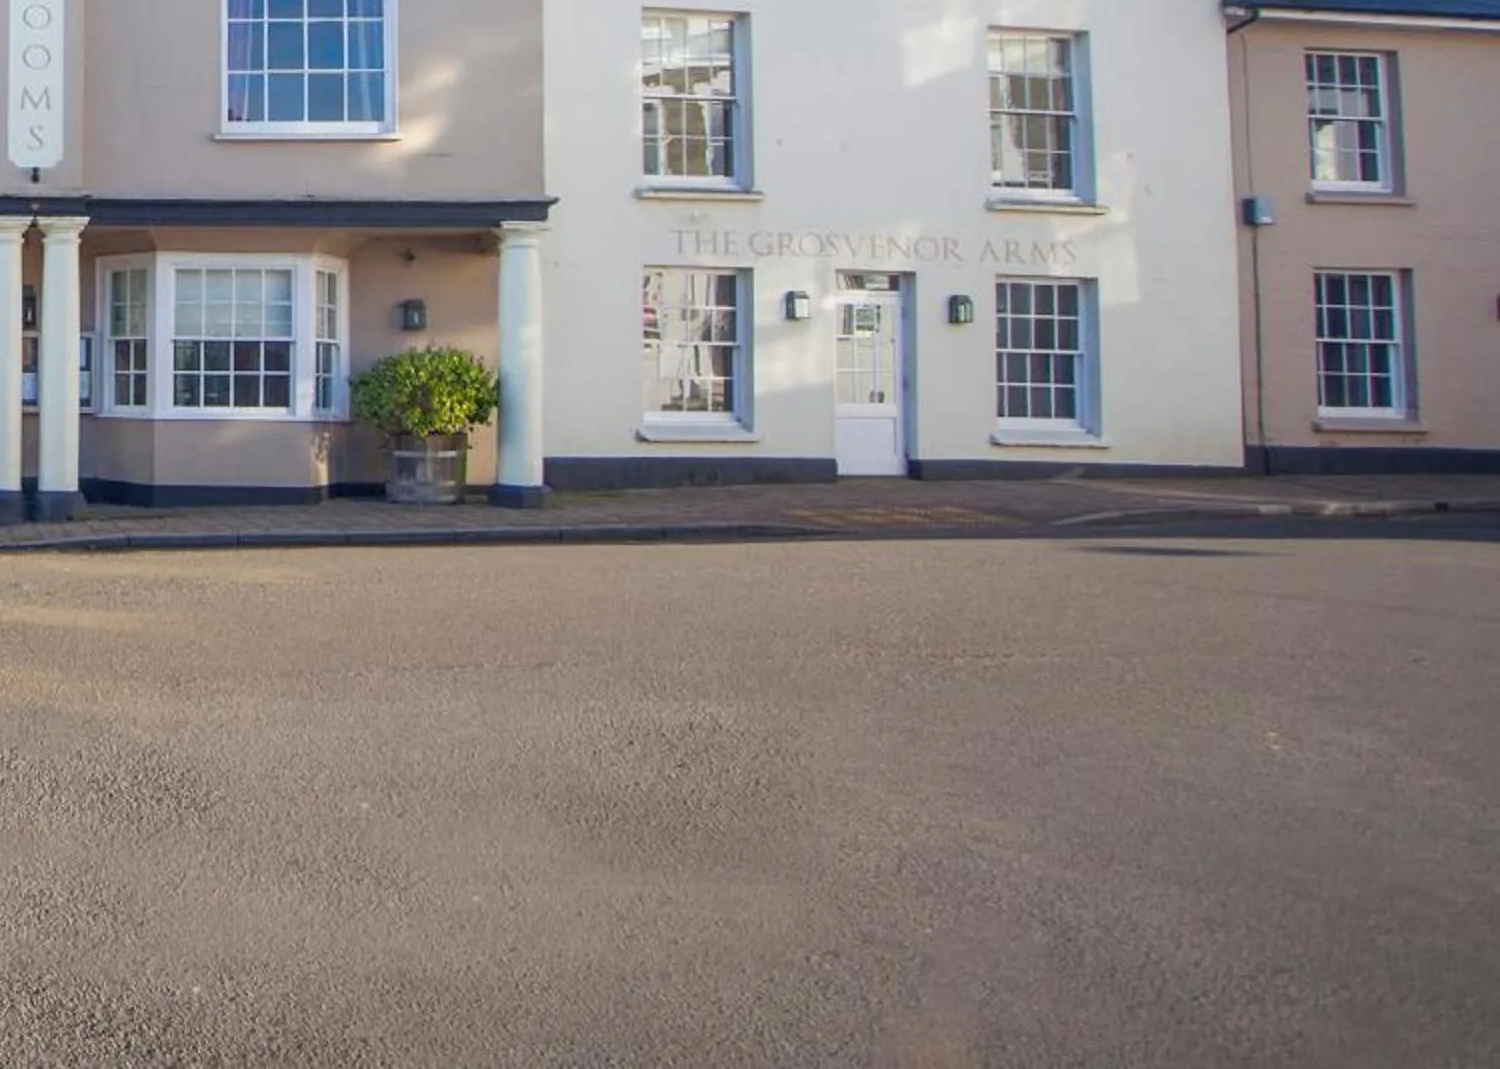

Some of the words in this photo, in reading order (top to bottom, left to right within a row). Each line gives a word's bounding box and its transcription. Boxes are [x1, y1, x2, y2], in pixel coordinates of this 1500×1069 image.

[670, 228, 740, 257] THE
[748, 230, 965, 264] GROSVENOR
[979, 238, 1077, 266] ARMS
